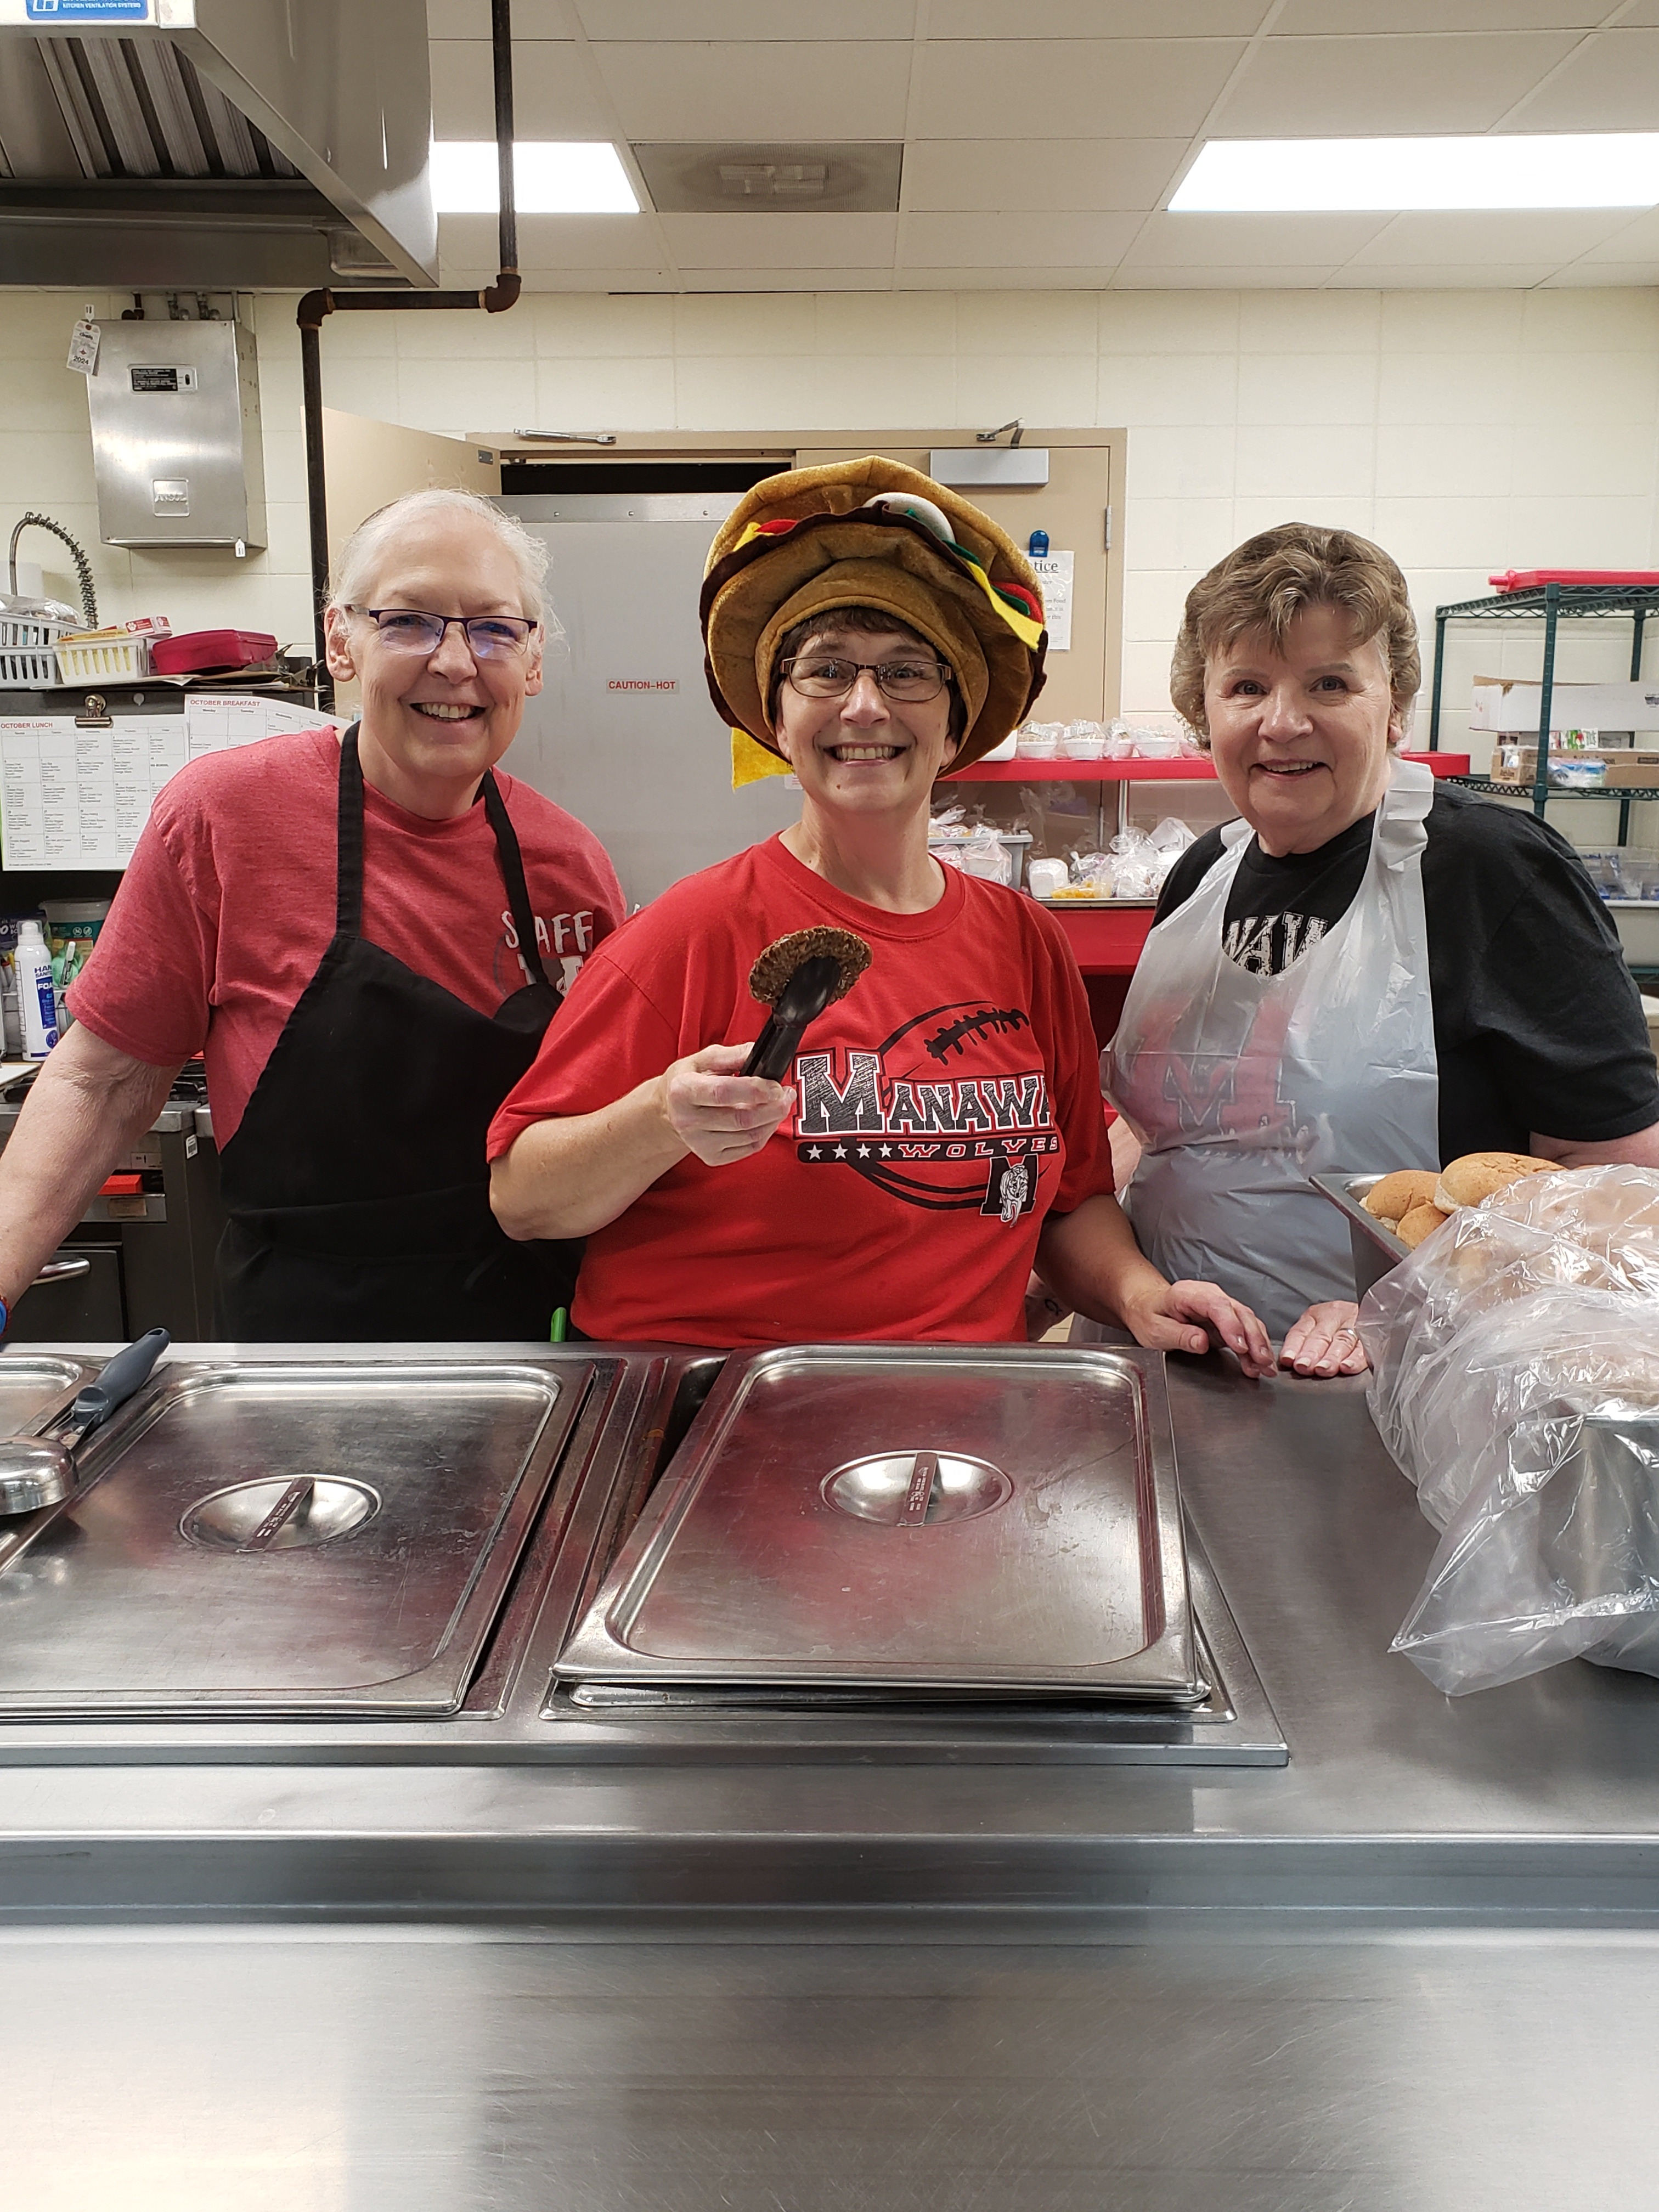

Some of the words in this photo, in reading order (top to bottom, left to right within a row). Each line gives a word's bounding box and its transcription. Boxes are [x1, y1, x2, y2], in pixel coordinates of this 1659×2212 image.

[73, 355, 89, 365] 2024
[1034, 560, 1058, 572] tice
[501, 911, 593, 953] SAFF
[35, 965, 52, 973] HAN
[898, 1136, 1058, 1159] WOLVES
